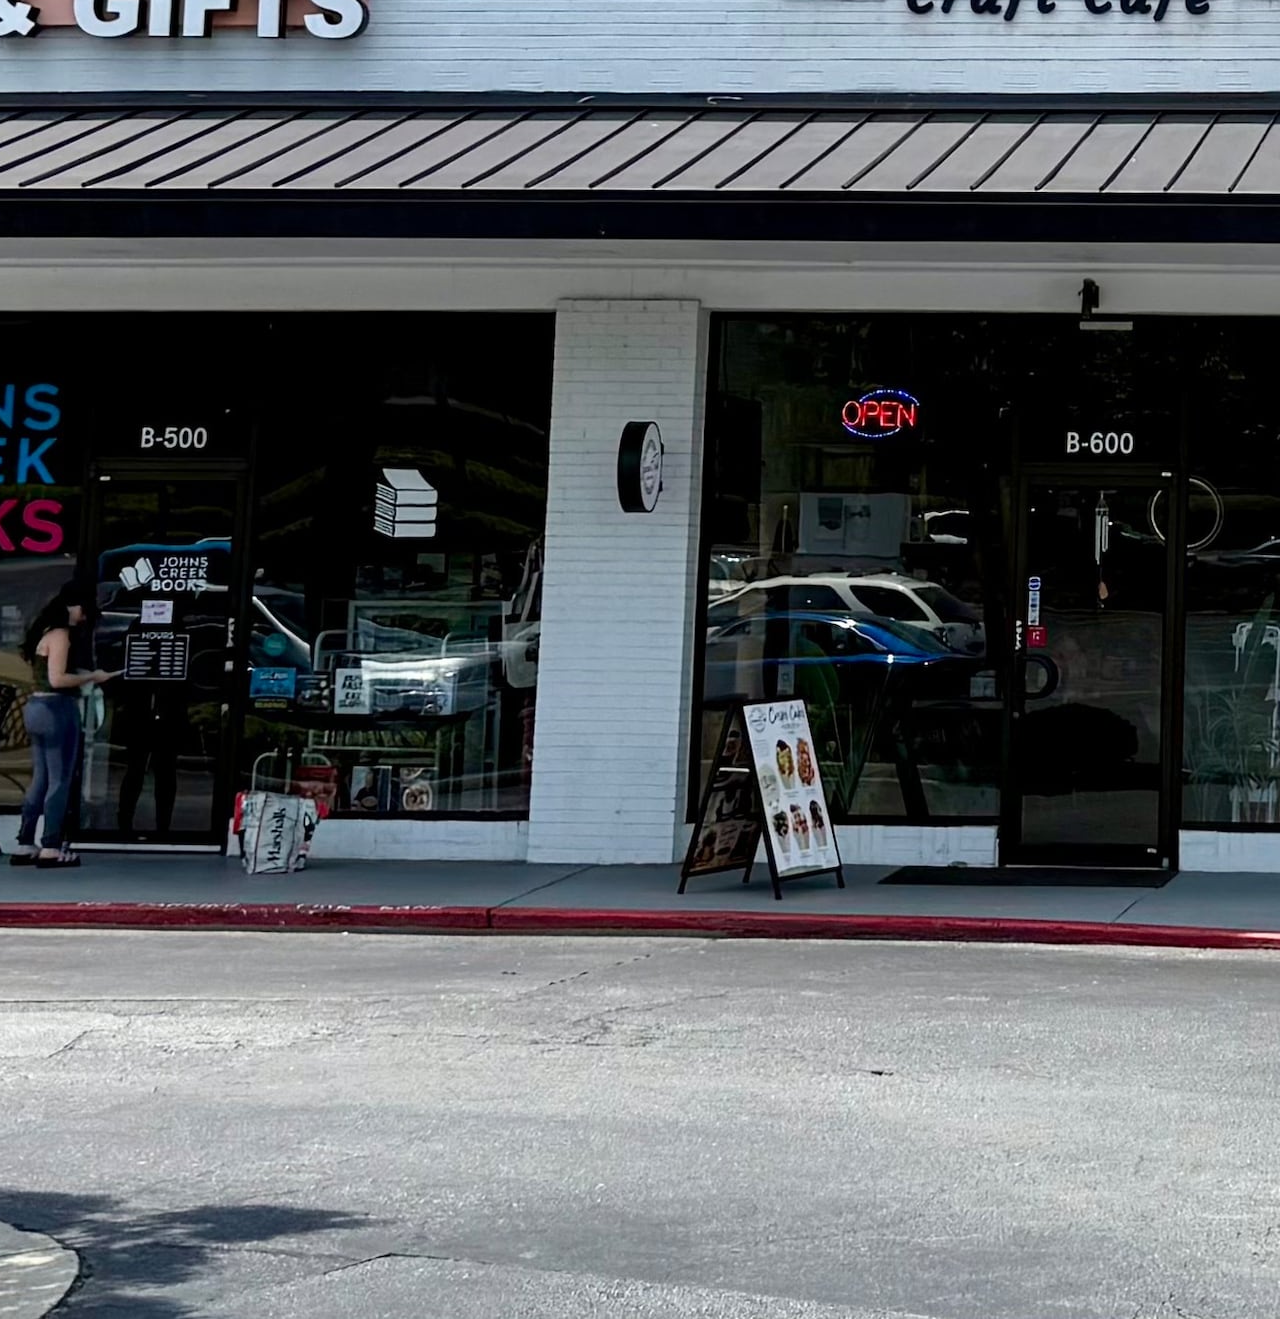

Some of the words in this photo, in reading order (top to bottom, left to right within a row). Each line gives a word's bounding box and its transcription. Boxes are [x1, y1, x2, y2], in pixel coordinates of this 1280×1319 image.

[842, 400, 915, 428] OPEN
[140, 427, 208, 448] B-500
[1066, 432, 1133, 454] B-600
[159, 556, 209, 567] JOHNS
[159, 567, 208, 579] CREEK
[151, 579, 208, 591] BOOKS
